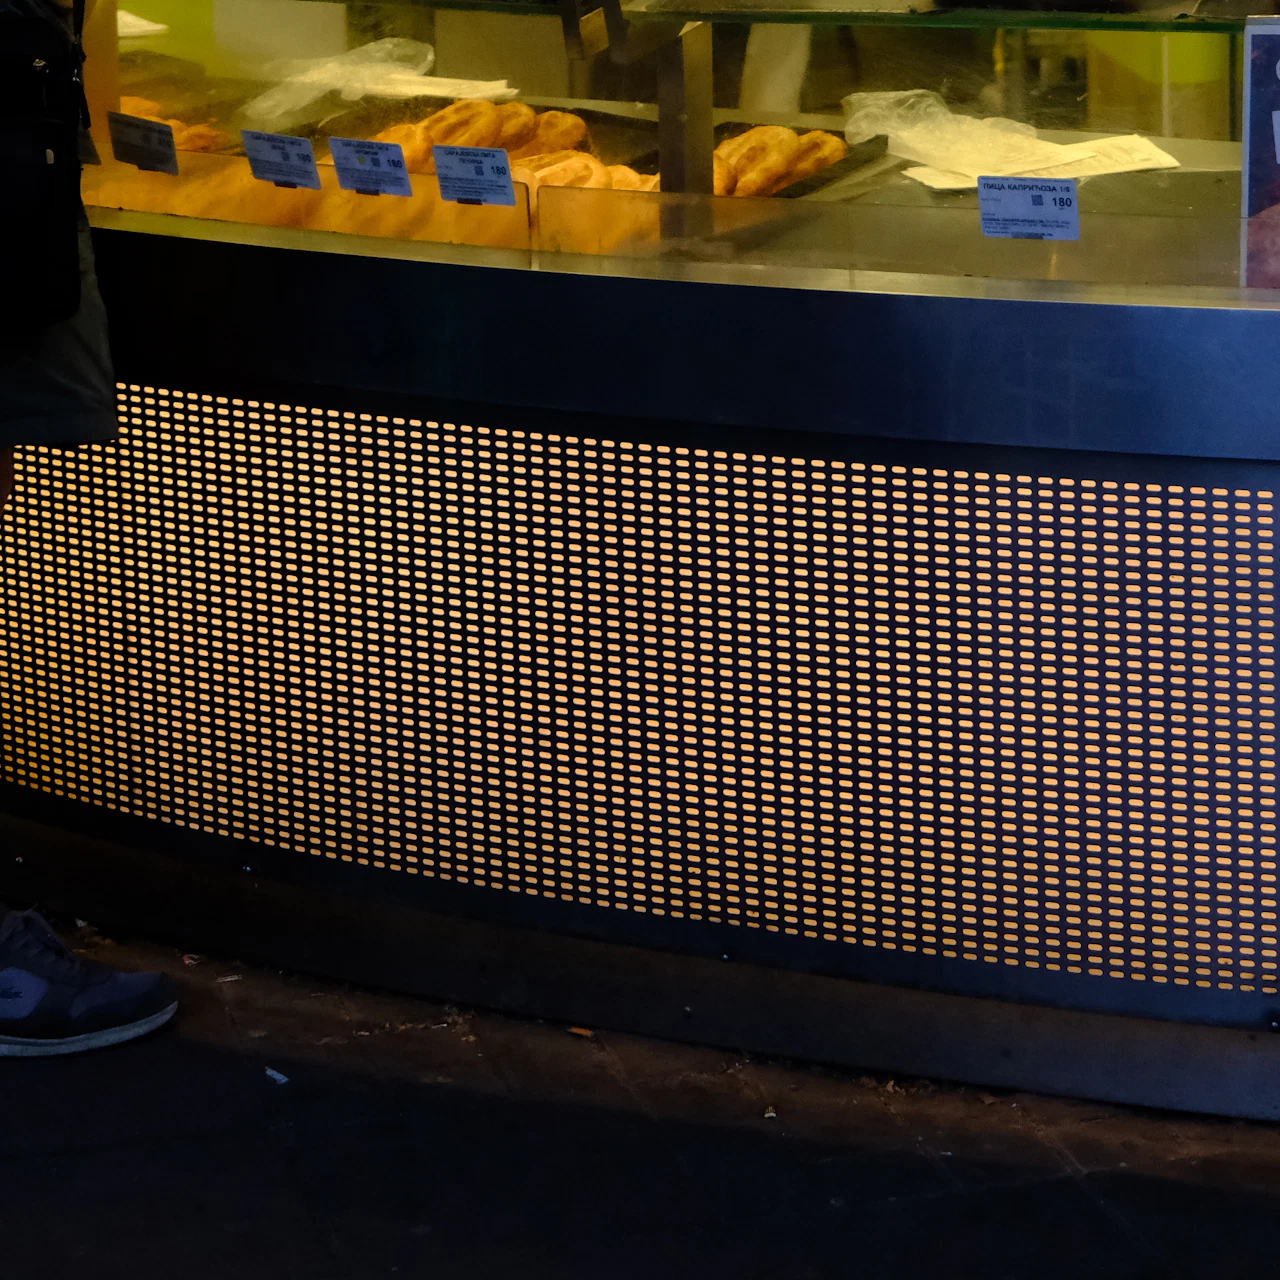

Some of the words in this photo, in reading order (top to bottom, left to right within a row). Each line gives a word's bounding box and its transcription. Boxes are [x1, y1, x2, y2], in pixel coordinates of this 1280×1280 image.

[490, 165, 507, 176] 180
[983, 183, 1006, 191] ПИЦА
[1007, 183, 1058, 192] КАПРИЋОЗА
[1051, 197, 1073, 207] 180
